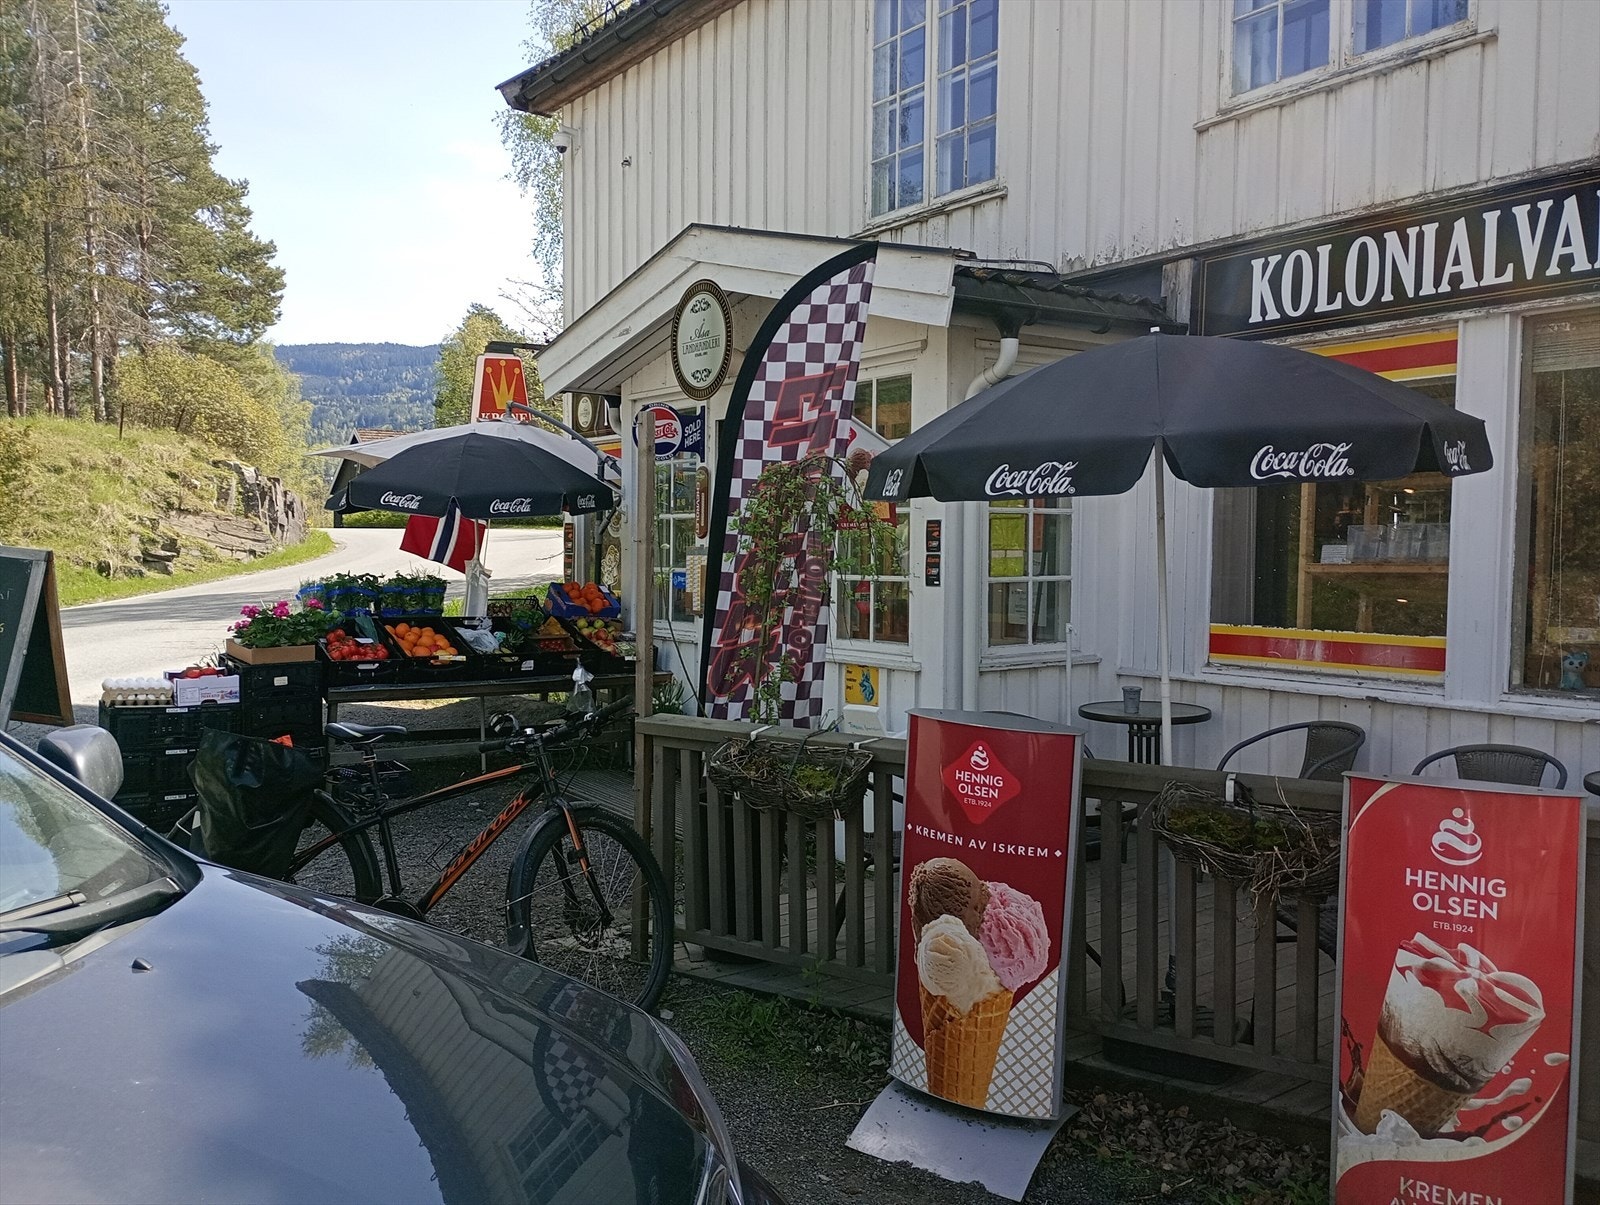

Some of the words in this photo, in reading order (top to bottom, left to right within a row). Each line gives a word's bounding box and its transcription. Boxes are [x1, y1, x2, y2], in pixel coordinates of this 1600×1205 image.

[1248, 190, 1600, 324] KOLONIALVA
[690, 319, 710, 341] Åsa
[684, 419, 702, 437] SOLD
[684, 430, 702, 448] HERE
[1250, 442, 1353, 480] Coca-Cola
[984, 461, 1079, 496] Coca-Cola
[380, 490, 423, 510] Coca-Cola
[489, 497, 533, 514] Coca-Cola
[955, 769, 1004, 788] HENNIG
[958, 782, 999, 799] OLSEN
[915, 825, 963, 846] KREMEN
[968, 838, 987, 850] AV
[992, 842, 1049, 858] ISKREM
[1405, 868, 1507, 898] HENNIG
[1412, 892, 1498, 920] OLSEN
[1433, 920, 1474, 934] ETB.1924
